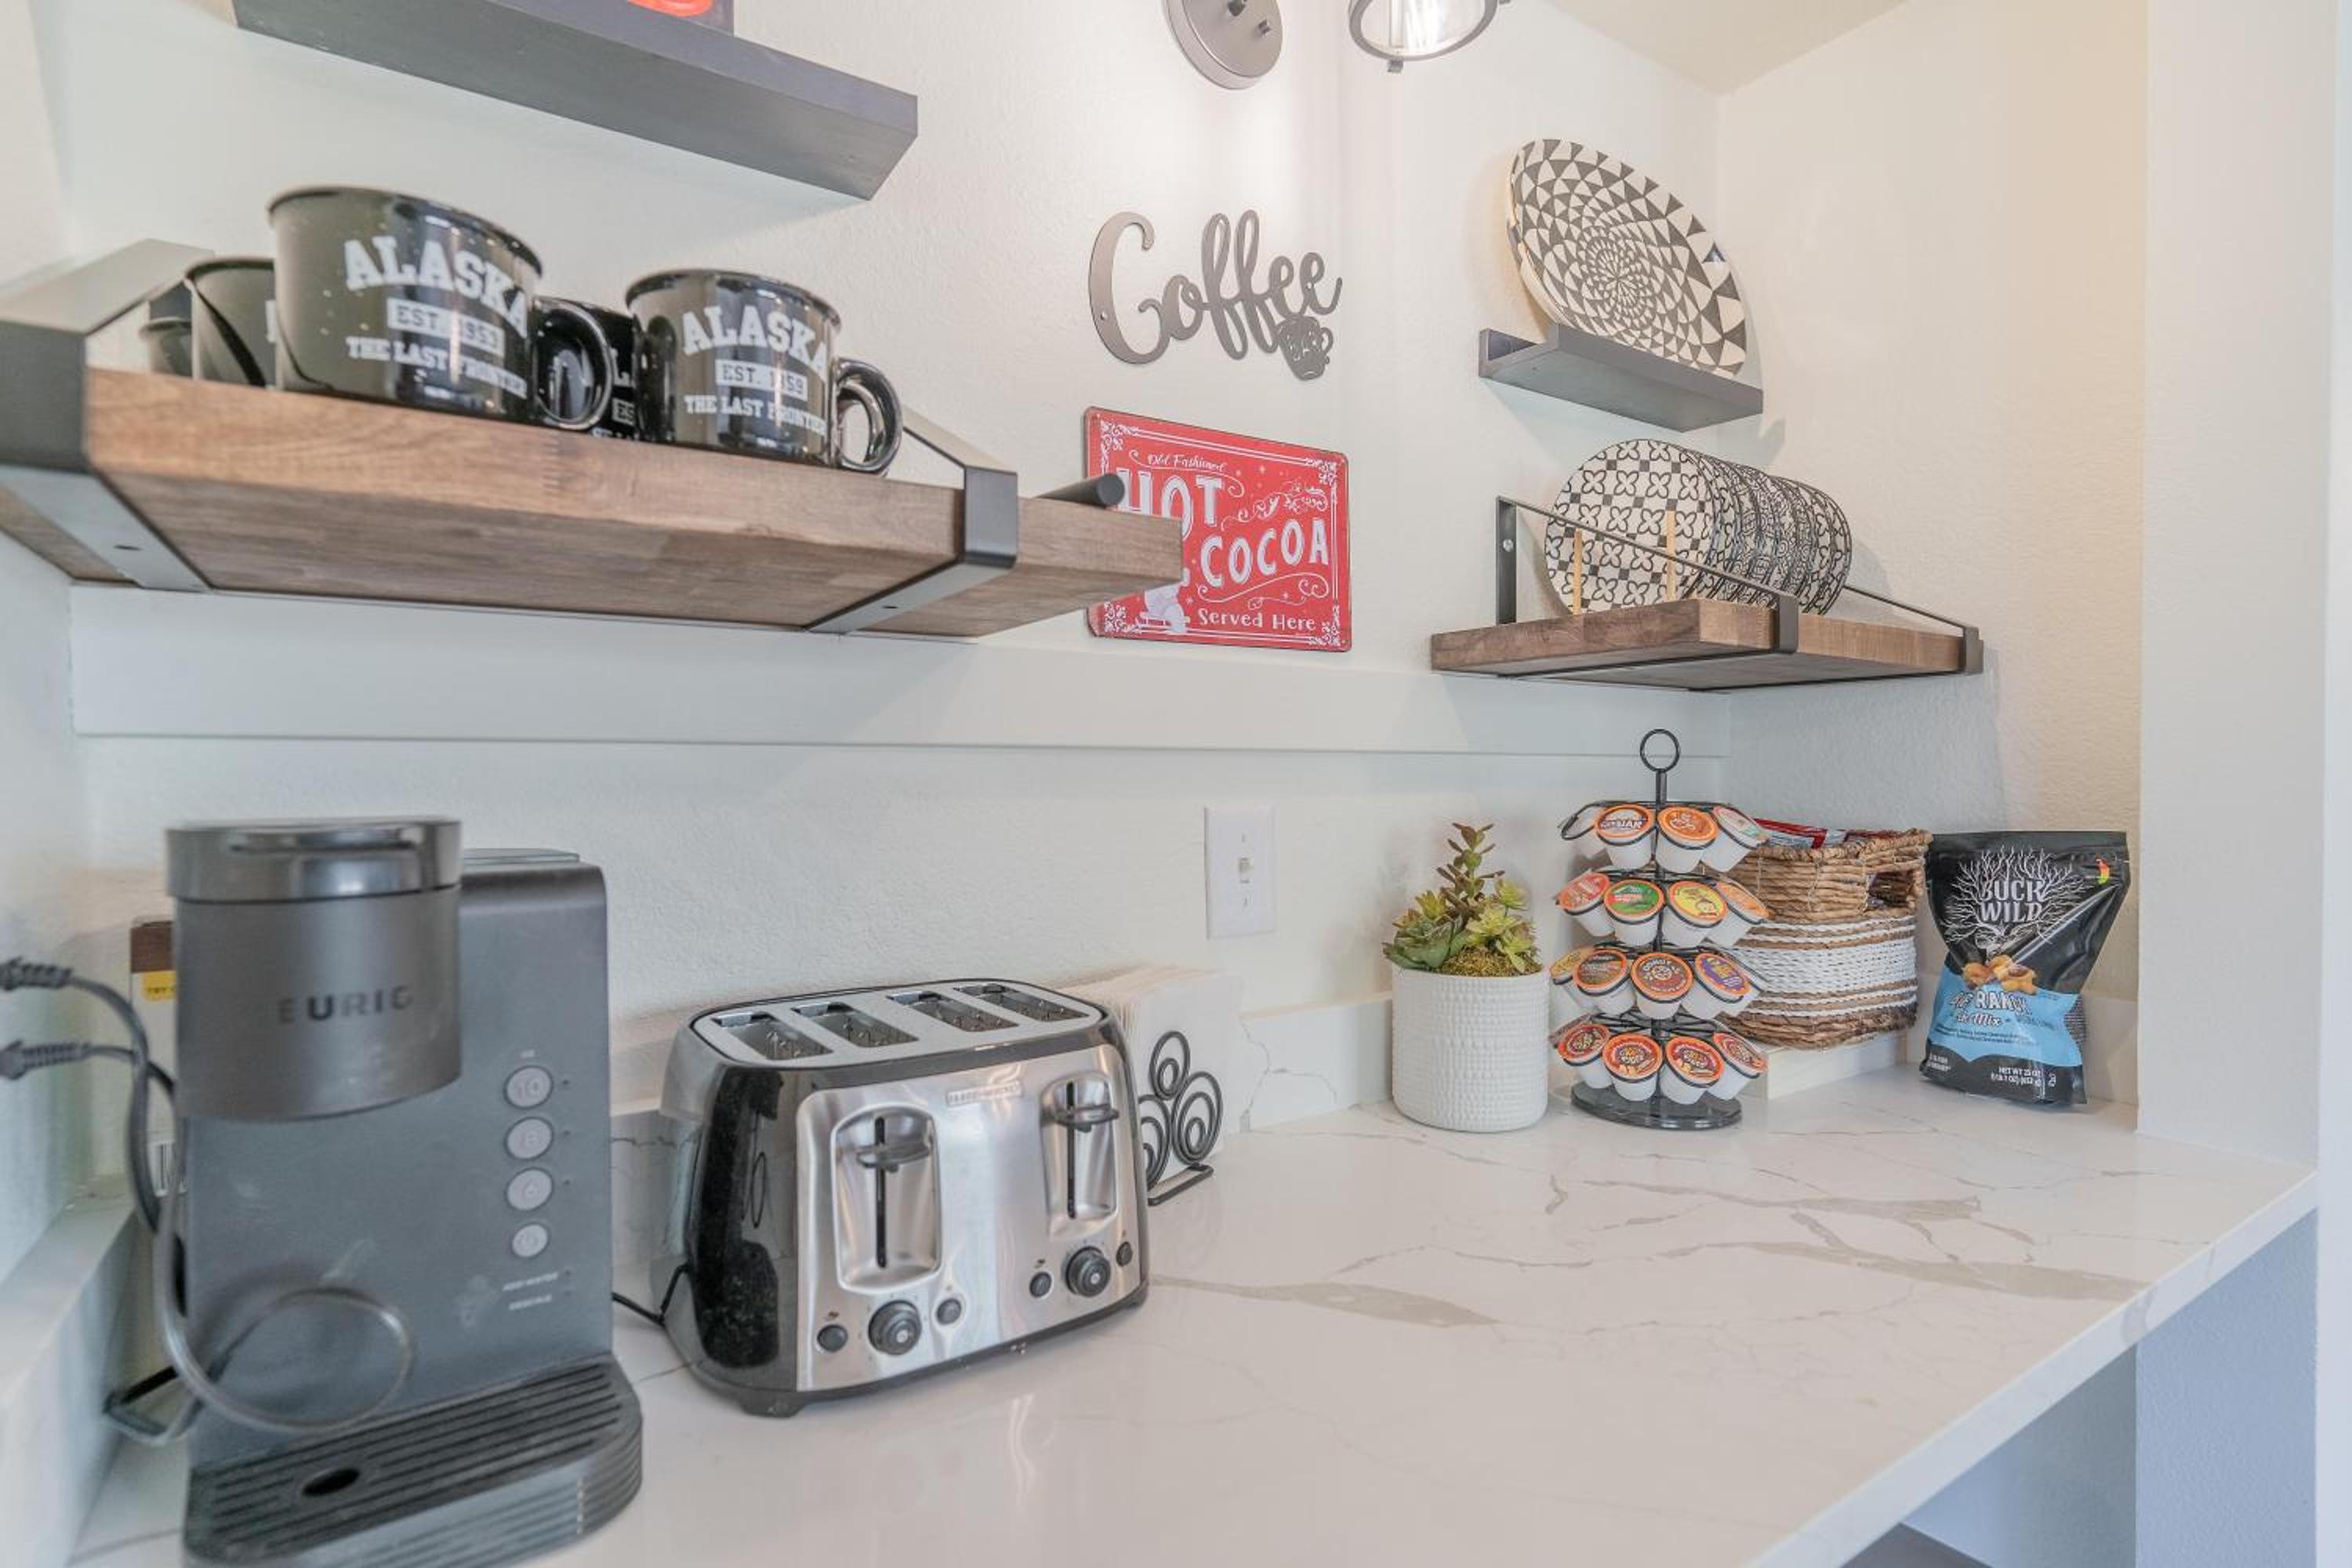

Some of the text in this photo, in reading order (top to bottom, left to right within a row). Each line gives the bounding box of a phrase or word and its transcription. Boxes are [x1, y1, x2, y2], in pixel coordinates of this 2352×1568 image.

[1088, 209, 1342, 365] Coffee
[346, 336, 390, 361] THE
[394, 340, 448, 370] LAST
[684, 394, 717, 414] THE
[720, 394, 764, 419] LAST
[1116, 467, 1224, 540] HOT
[1200, 517, 1330, 588] COCOA
[1197, 608, 1316, 630] Served Here
[1980, 901, 2042, 923] WILD
[277, 985, 415, 1025] EURIG
